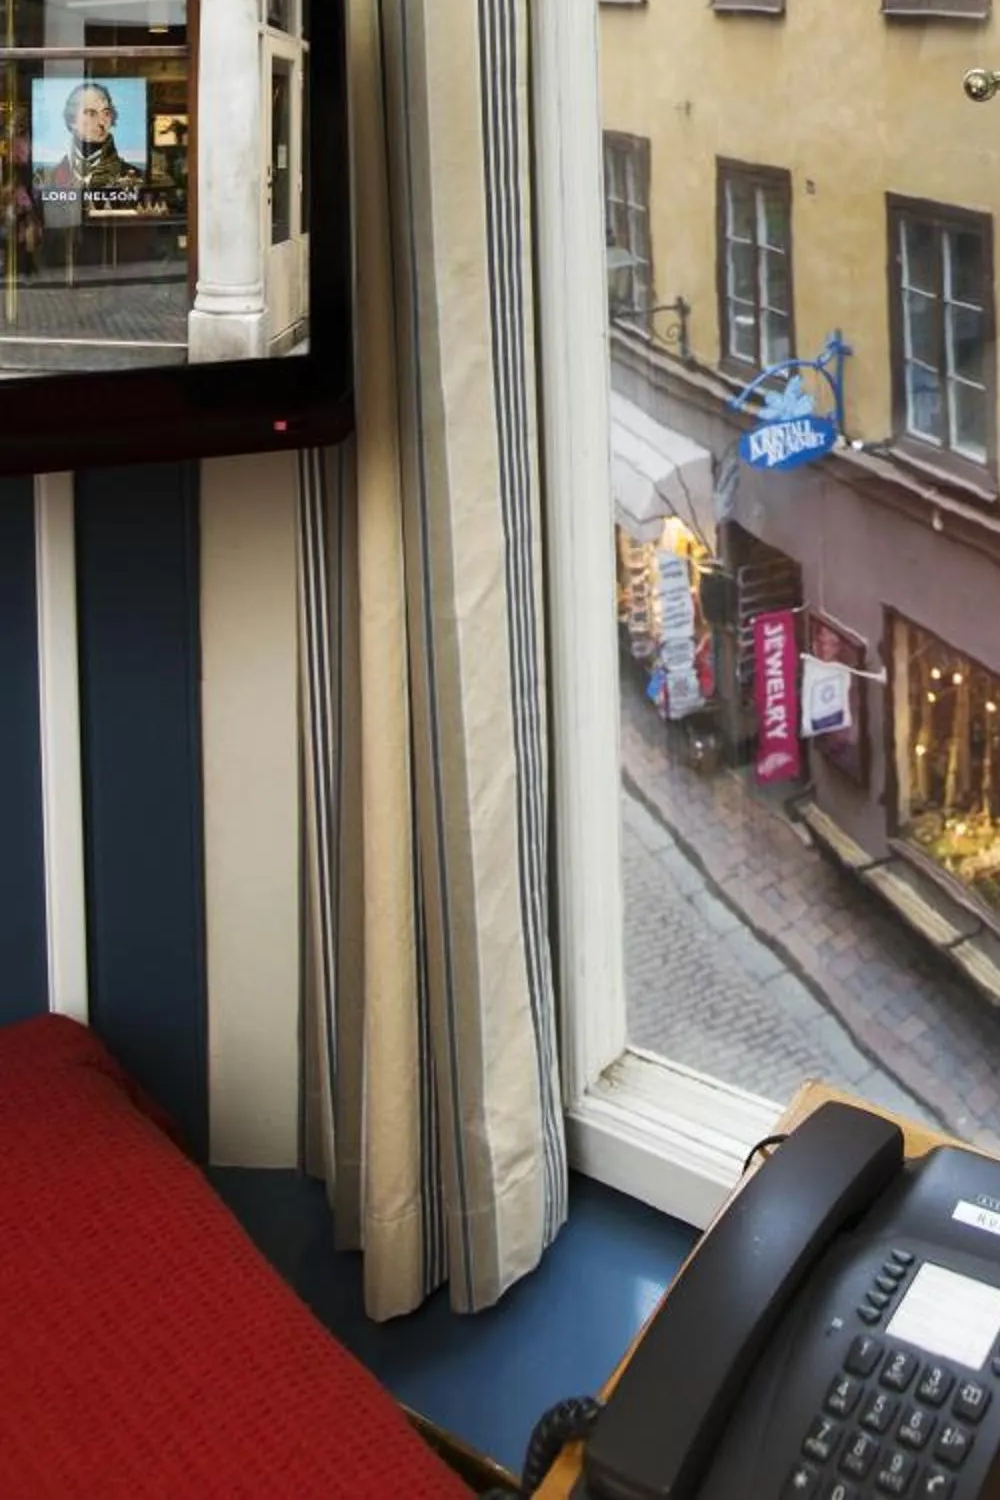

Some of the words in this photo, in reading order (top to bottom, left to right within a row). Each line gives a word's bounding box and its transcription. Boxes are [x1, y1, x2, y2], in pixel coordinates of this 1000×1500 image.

[41, 191, 77, 201] LORD
[83, 190, 138, 201] NELSON
[763, 623, 788, 739] JEWELRY
